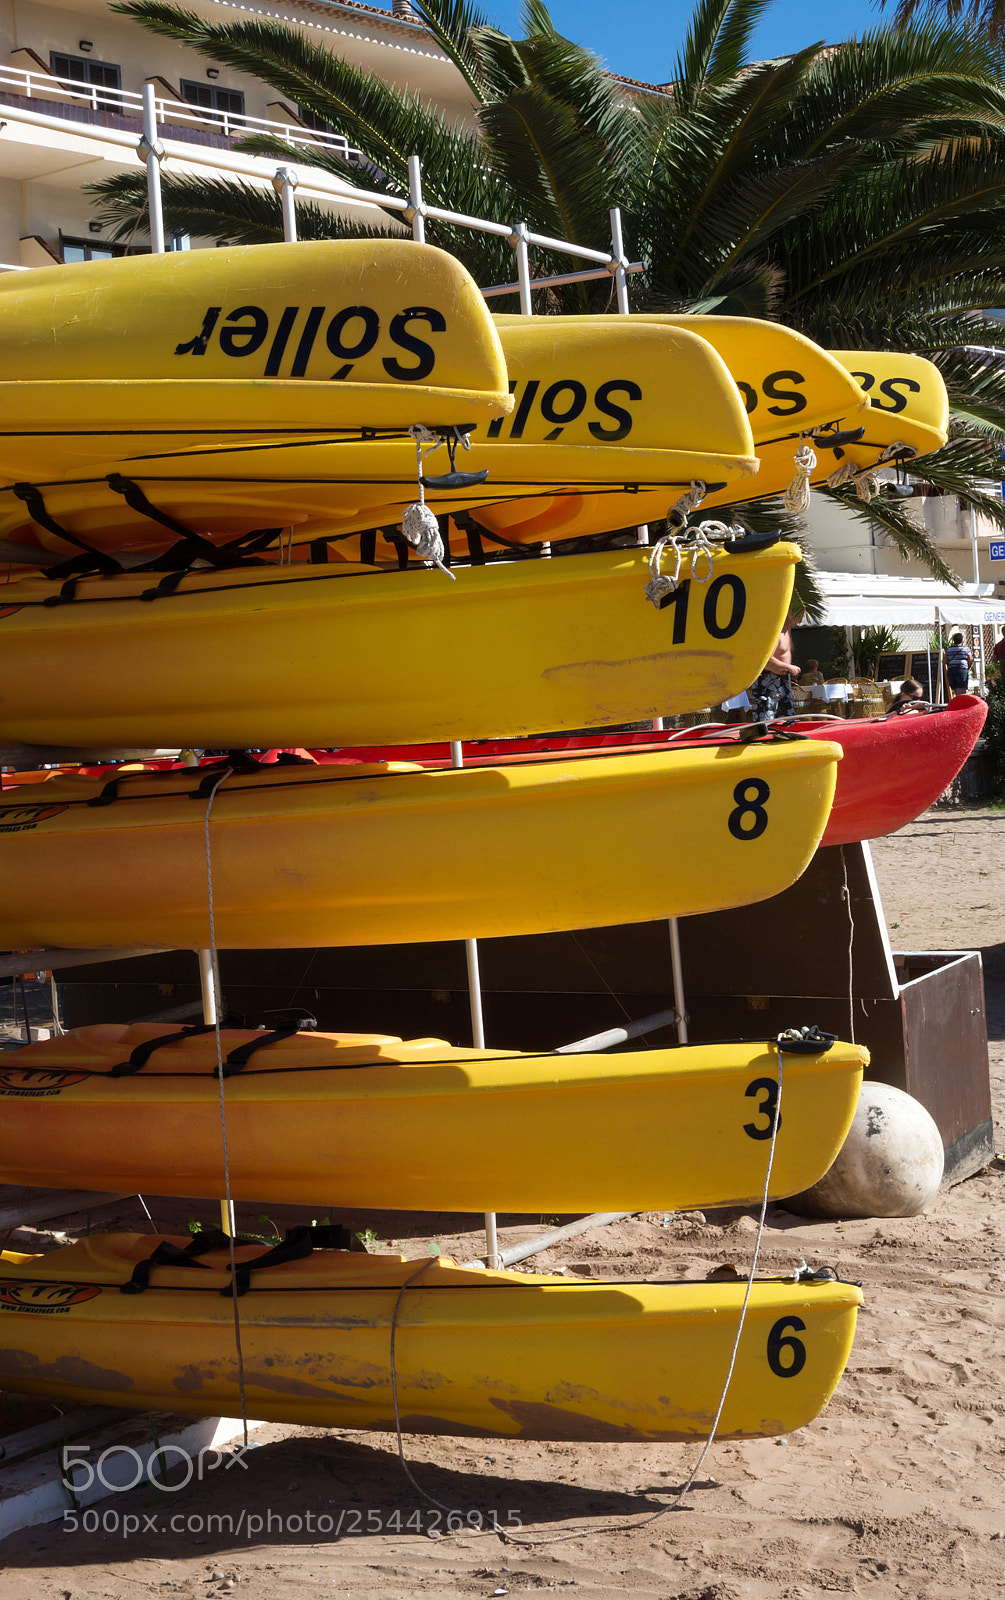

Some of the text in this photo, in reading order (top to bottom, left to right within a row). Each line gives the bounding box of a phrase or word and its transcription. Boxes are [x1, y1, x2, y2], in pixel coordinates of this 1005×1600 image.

[659, 574, 747, 645] 10
[728, 777, 771, 841] 8
[743, 1077, 783, 1141] 3
[767, 1315, 807, 1379] 6
